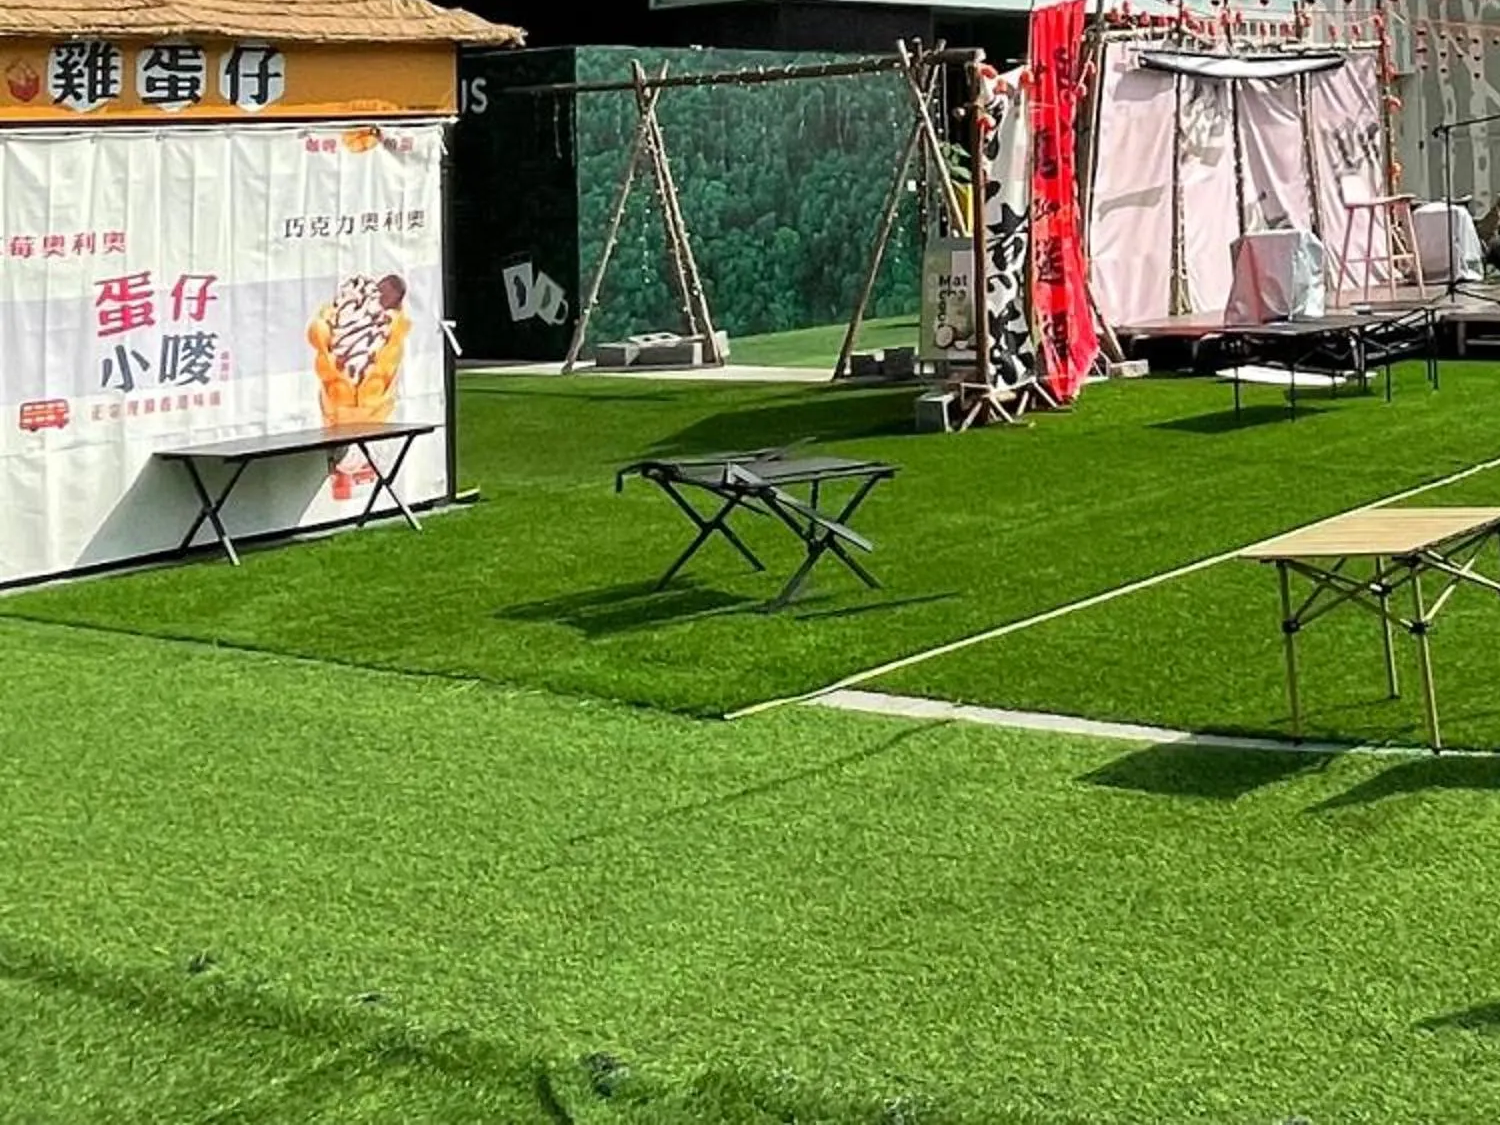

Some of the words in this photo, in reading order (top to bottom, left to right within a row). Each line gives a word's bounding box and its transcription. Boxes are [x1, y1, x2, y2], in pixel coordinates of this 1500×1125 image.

[52, 42, 282, 105] 雞蛋仔
[461, 77, 488, 114] S
[285, 210, 425, 238] 巧克力奥利奥
[0, 232, 126, 259] 莓奥利奥
[94, 271, 217, 338] 蛋仔
